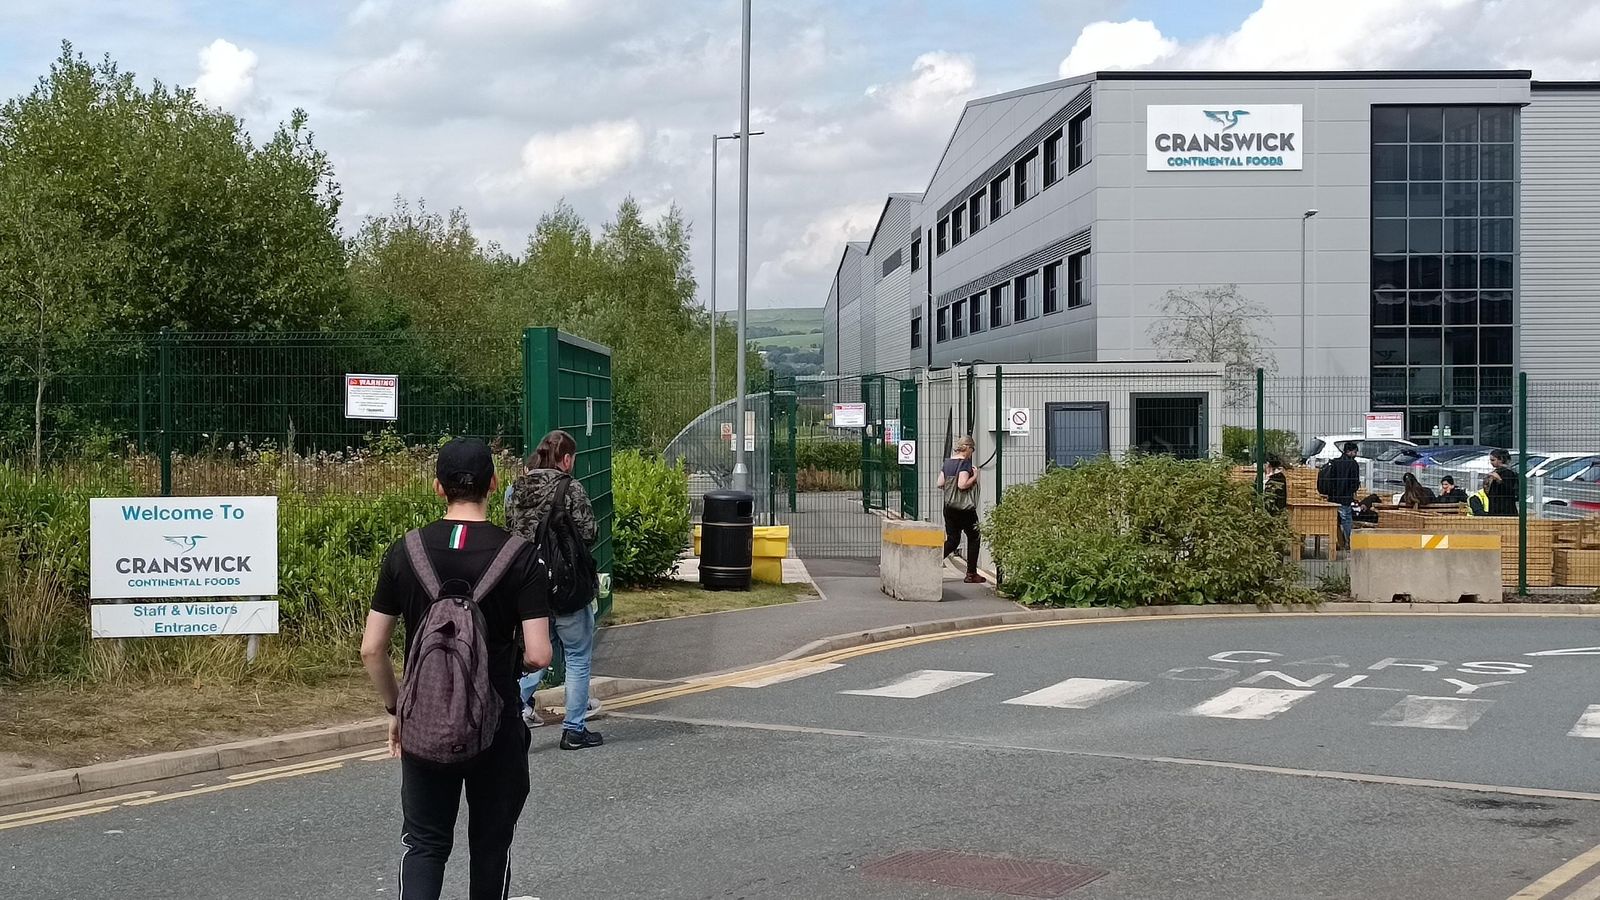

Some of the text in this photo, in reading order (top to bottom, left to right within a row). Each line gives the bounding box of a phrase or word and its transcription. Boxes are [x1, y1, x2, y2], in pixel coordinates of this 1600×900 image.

[1155, 132, 1295, 152] CRANSWICK
[1167, 156, 1283, 166] CONTINENTAL FOODS
[121, 504, 245, 521] Welcome To
[115, 556, 252, 574] CRANSWICK
[128, 577, 241, 588] CONTINENTAL FOODS
[133, 603, 238, 617] Staff & Visitors
[154, 622, 218, 634] Entrance
[1207, 650, 1533, 675] CARS
[1159, 666, 1514, 694] ONLY
